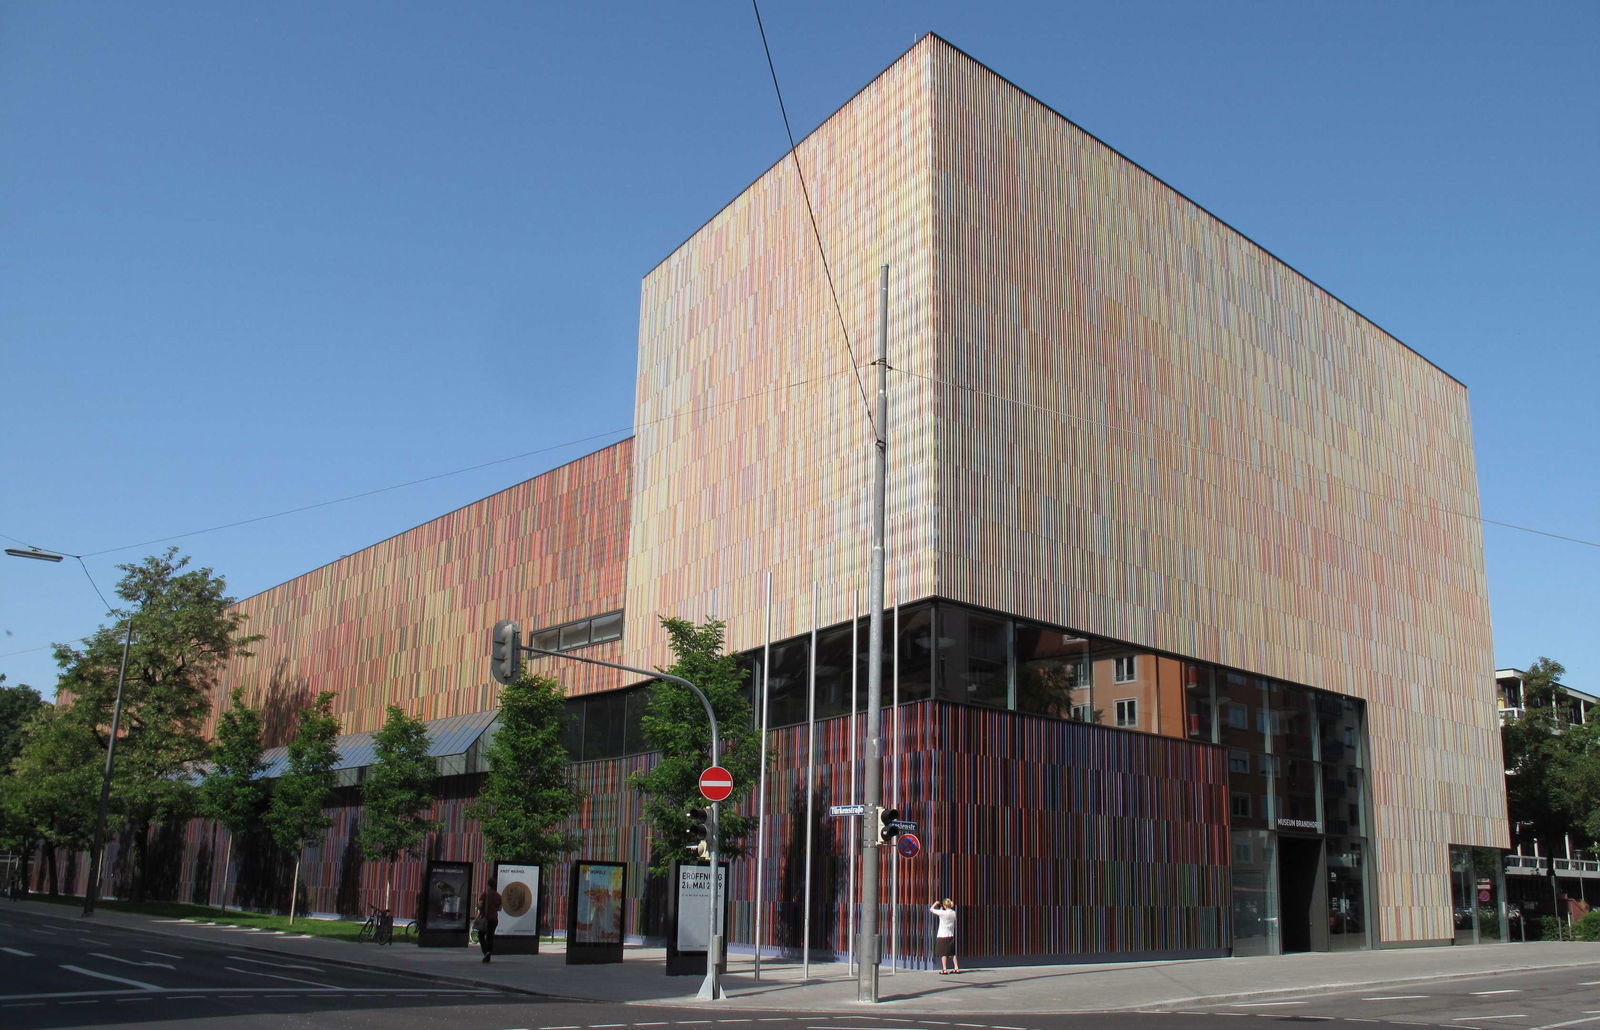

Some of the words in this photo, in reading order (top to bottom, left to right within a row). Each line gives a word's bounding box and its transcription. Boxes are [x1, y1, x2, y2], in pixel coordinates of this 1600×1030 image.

[1277, 818, 1295, 827] MUSEUM
[682, 871, 722, 881] ERÖFFNG
[693, 881, 705, 890] MAI
[706, 881, 722, 890] 29
